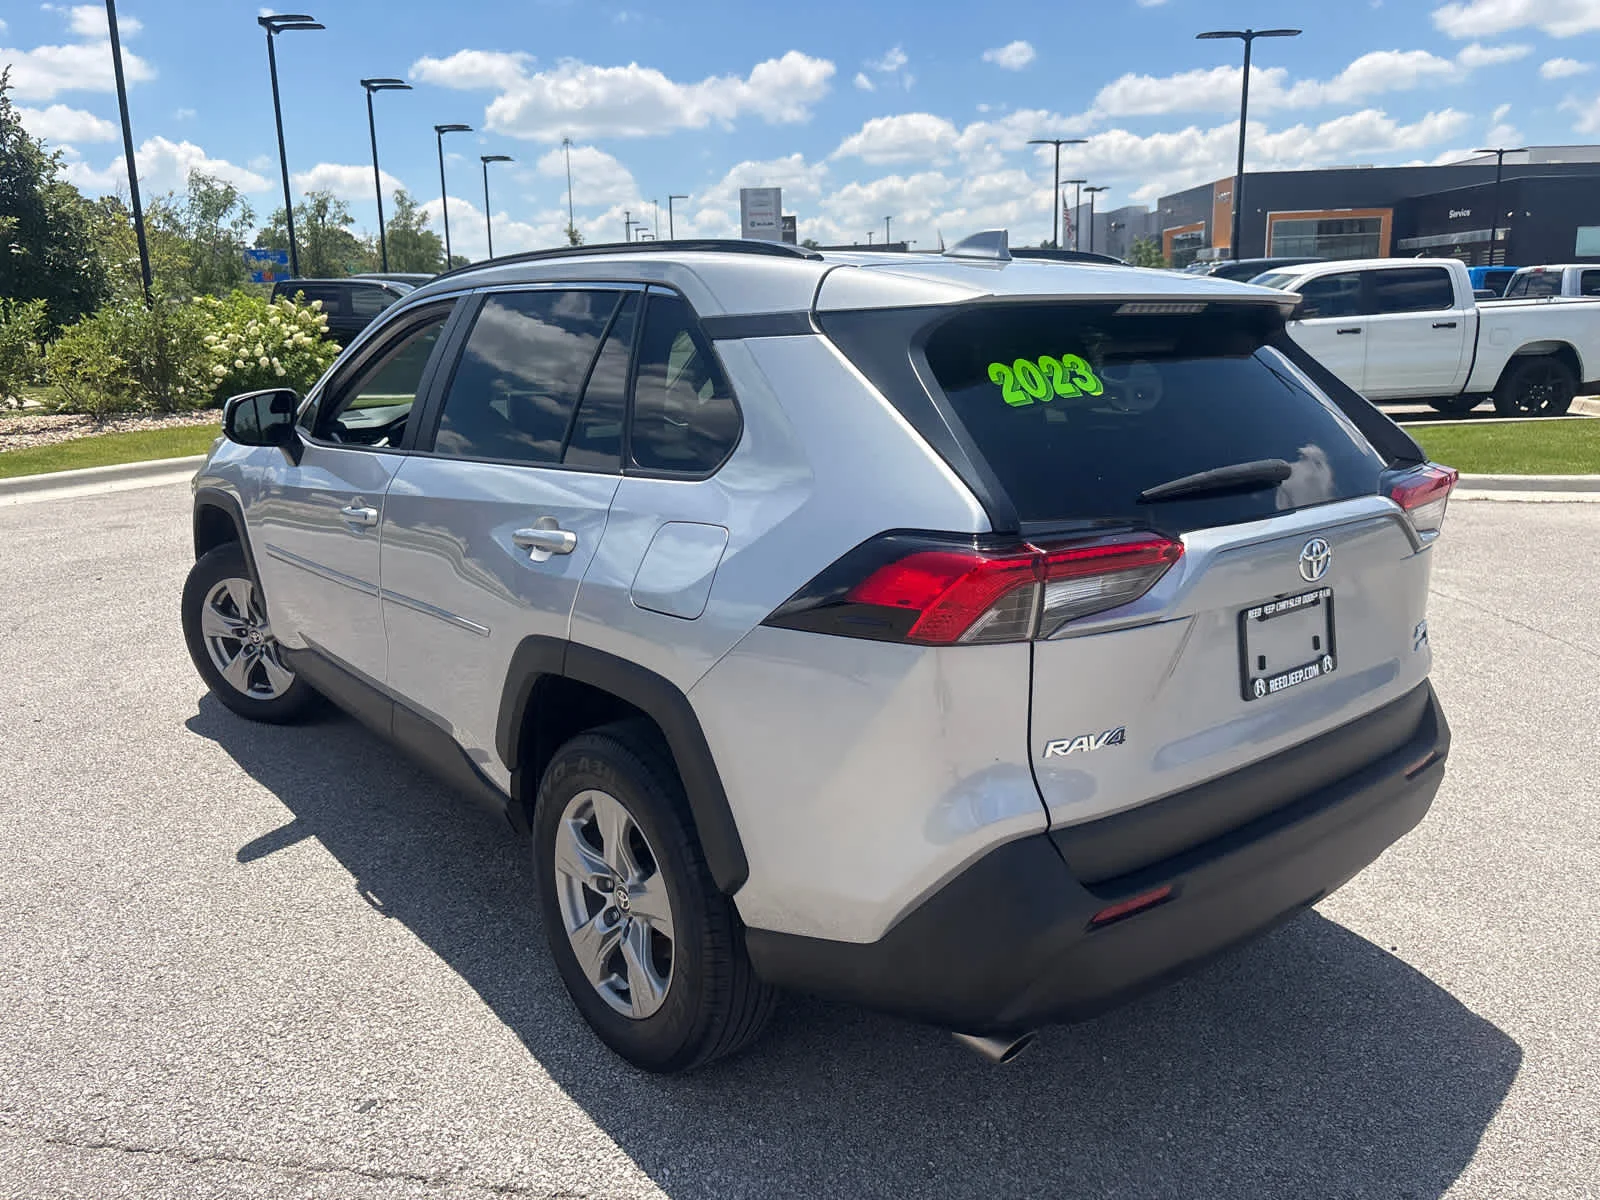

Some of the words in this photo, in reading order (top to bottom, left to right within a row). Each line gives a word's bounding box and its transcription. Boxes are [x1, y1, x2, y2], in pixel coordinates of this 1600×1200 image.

[1448, 208, 1472, 219] Service
[988, 354, 1103, 407] 2023
[1248, 607, 1262, 619] REED
[1276, 596, 1302, 611] CHRYSLER
[1269, 664, 1319, 692] REEDJEEP.COM
[1042, 726, 1126, 759] RAV4
